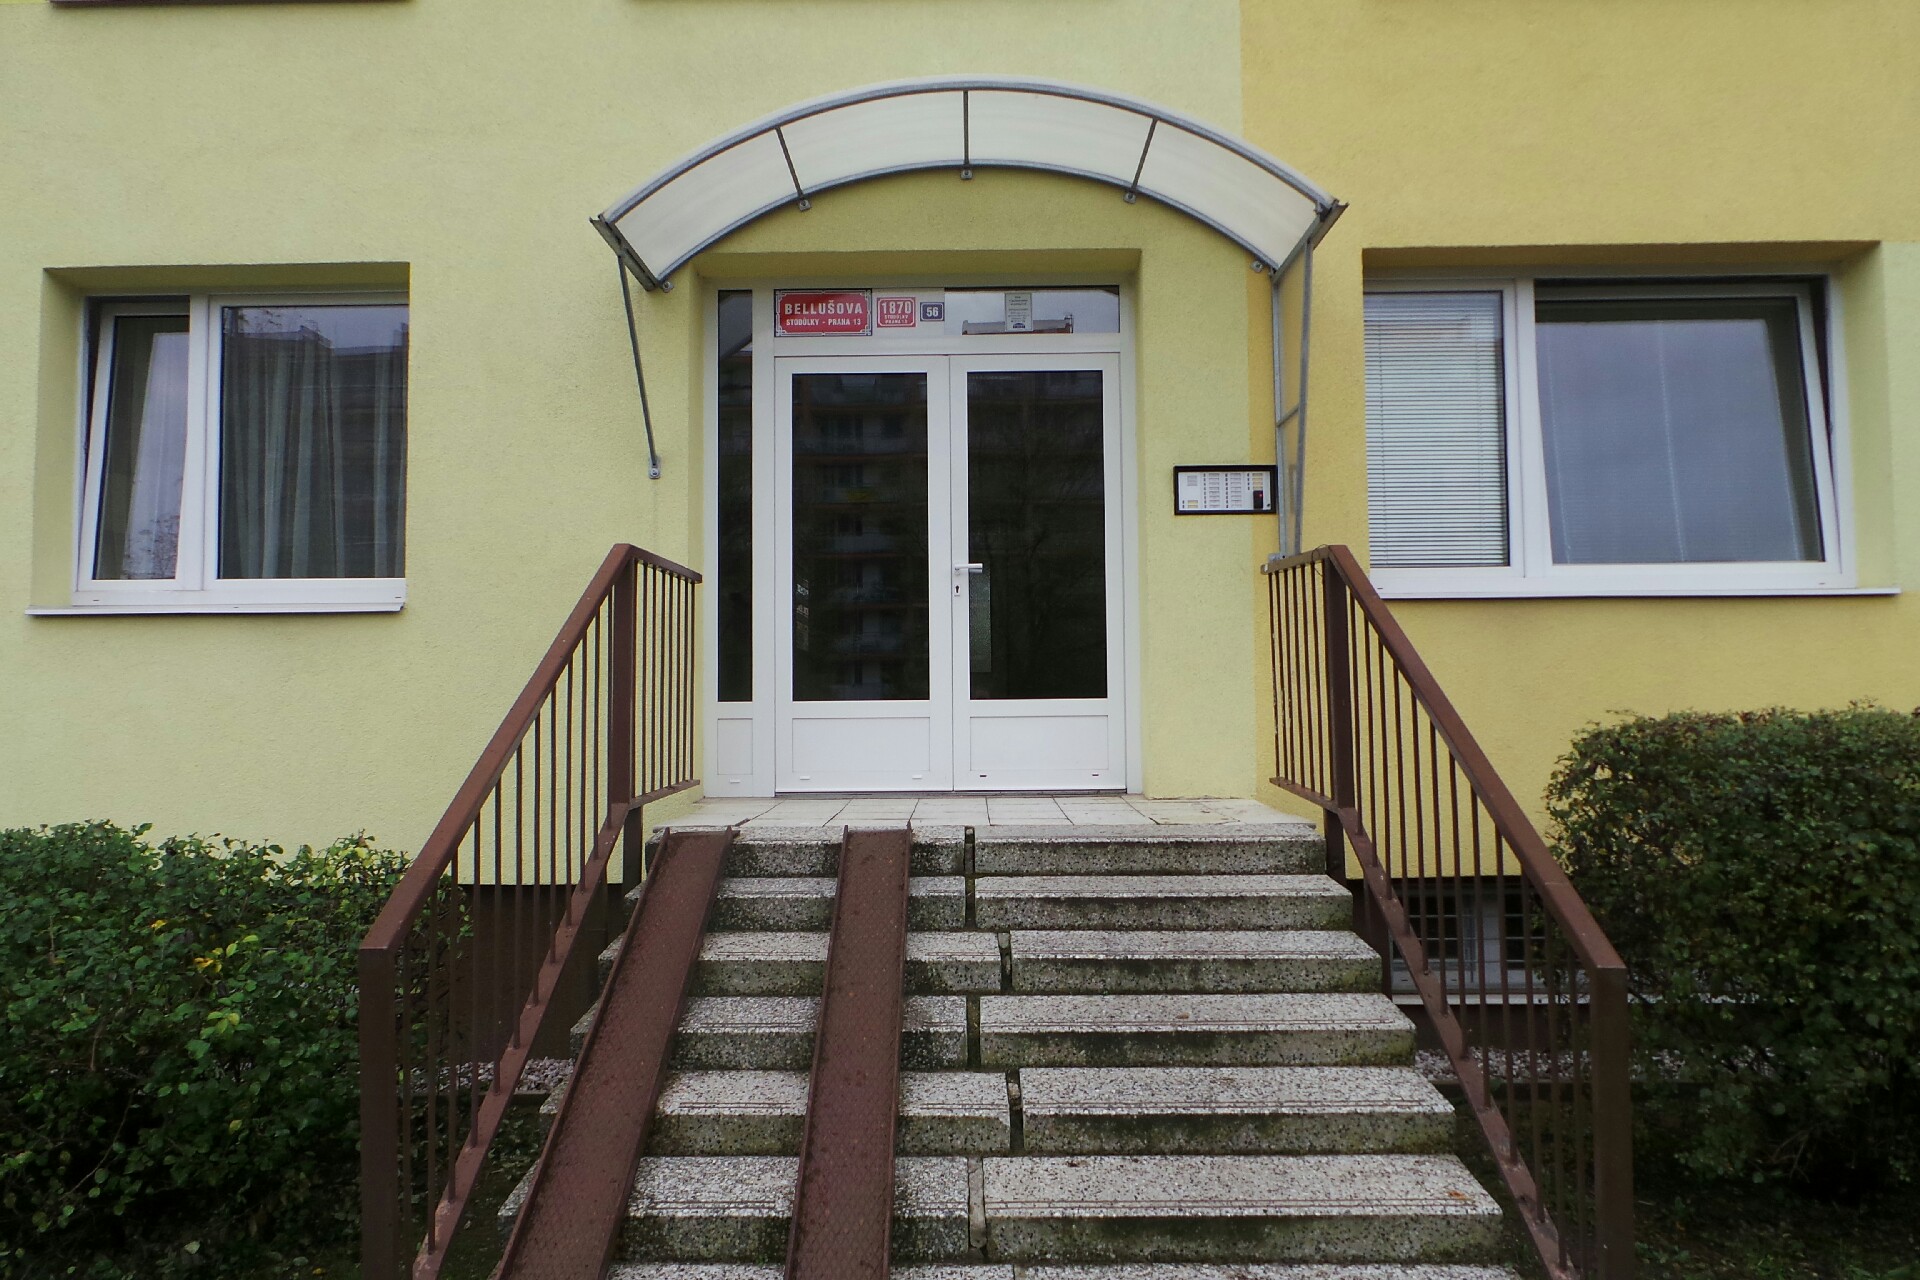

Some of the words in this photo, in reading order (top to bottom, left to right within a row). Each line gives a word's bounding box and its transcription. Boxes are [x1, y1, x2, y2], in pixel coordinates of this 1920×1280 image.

[784, 299, 863, 315] BELLUŠOVA
[882, 301, 912, 314] 1870
[926, 306, 939, 317] 56
[786, 317, 819, 326] STODŮLKY
[828, 318, 850, 326] PRAHA
[853, 318, 861, 326] 13
